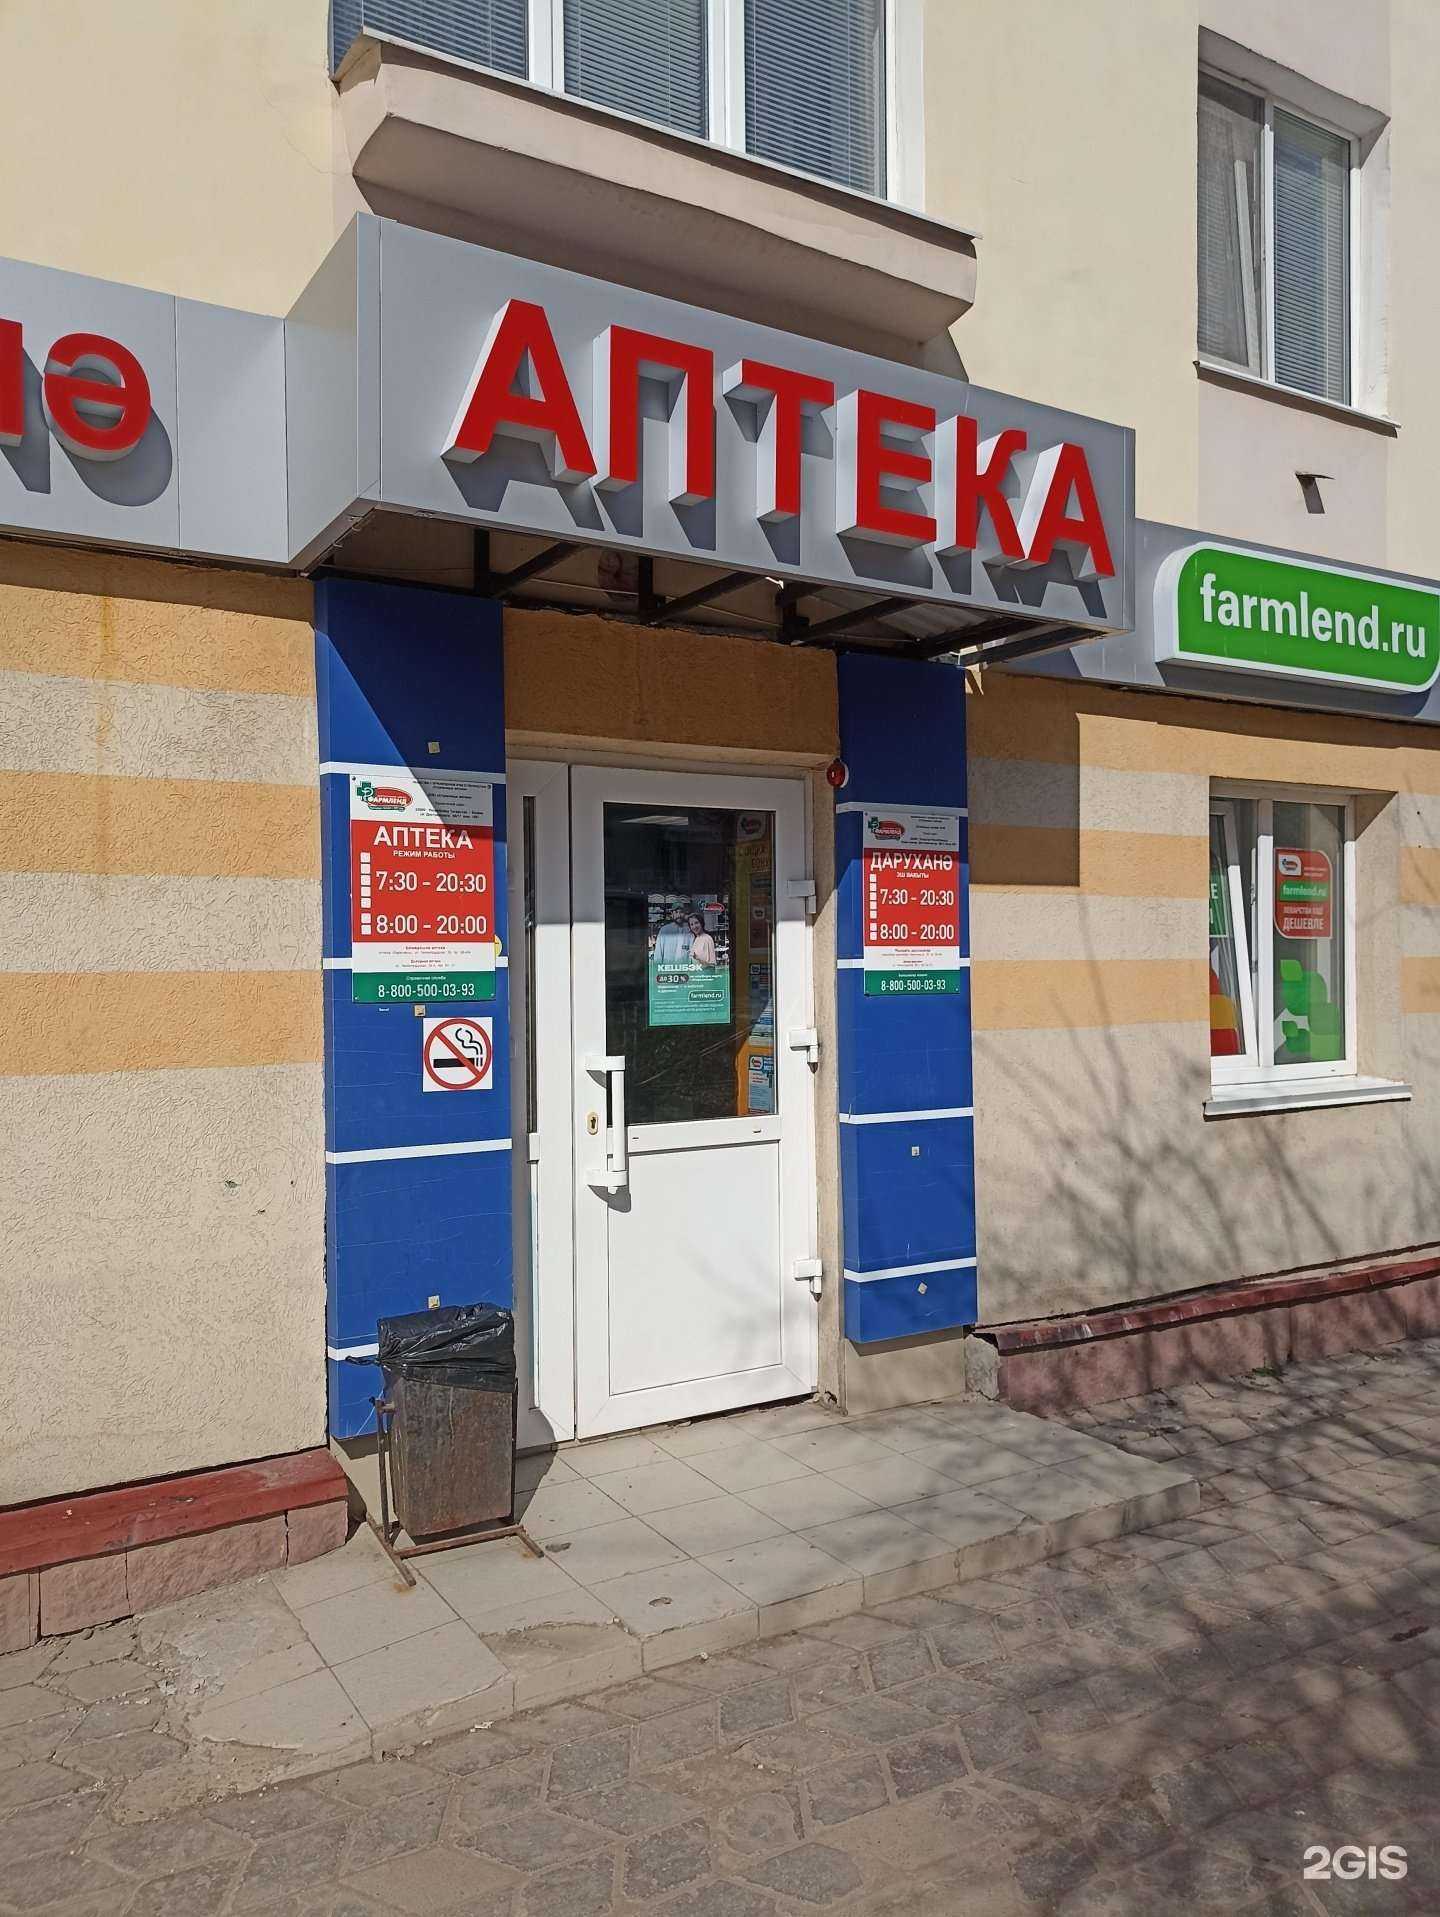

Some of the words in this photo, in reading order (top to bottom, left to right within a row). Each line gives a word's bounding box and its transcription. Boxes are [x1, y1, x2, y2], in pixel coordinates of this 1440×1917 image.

[450, 298, 1116, 578] АПТЕКА
[1199, 572, 1427, 659] farmlend.ru
[373, 825, 474, 849] АПТЕКА
[393, 850, 422, 859] РЕЖИМ
[423, 851, 456, 859] РАБОТЫ
[870, 852, 953, 872] ДАРУХАНӘ
[376, 870, 418, 891] 7:30
[435, 872, 487, 893] 20:30
[880, 888, 909, 905] 7:30
[919, 889, 954, 906] 20:30
[376, 914, 418, 935] 8:00
[435, 914, 487, 935] 20:00
[880, 923, 909, 940] 8:00
[919, 923, 954, 940] 20:00
[1283, 918, 1325, 932] ДЕШЕВЛЕ
[667, 975, 679, 983] 30
[881, 979, 946, 991] 8-800-500-03-93
[378, 983, 475, 998] 8-800-500-03-93
